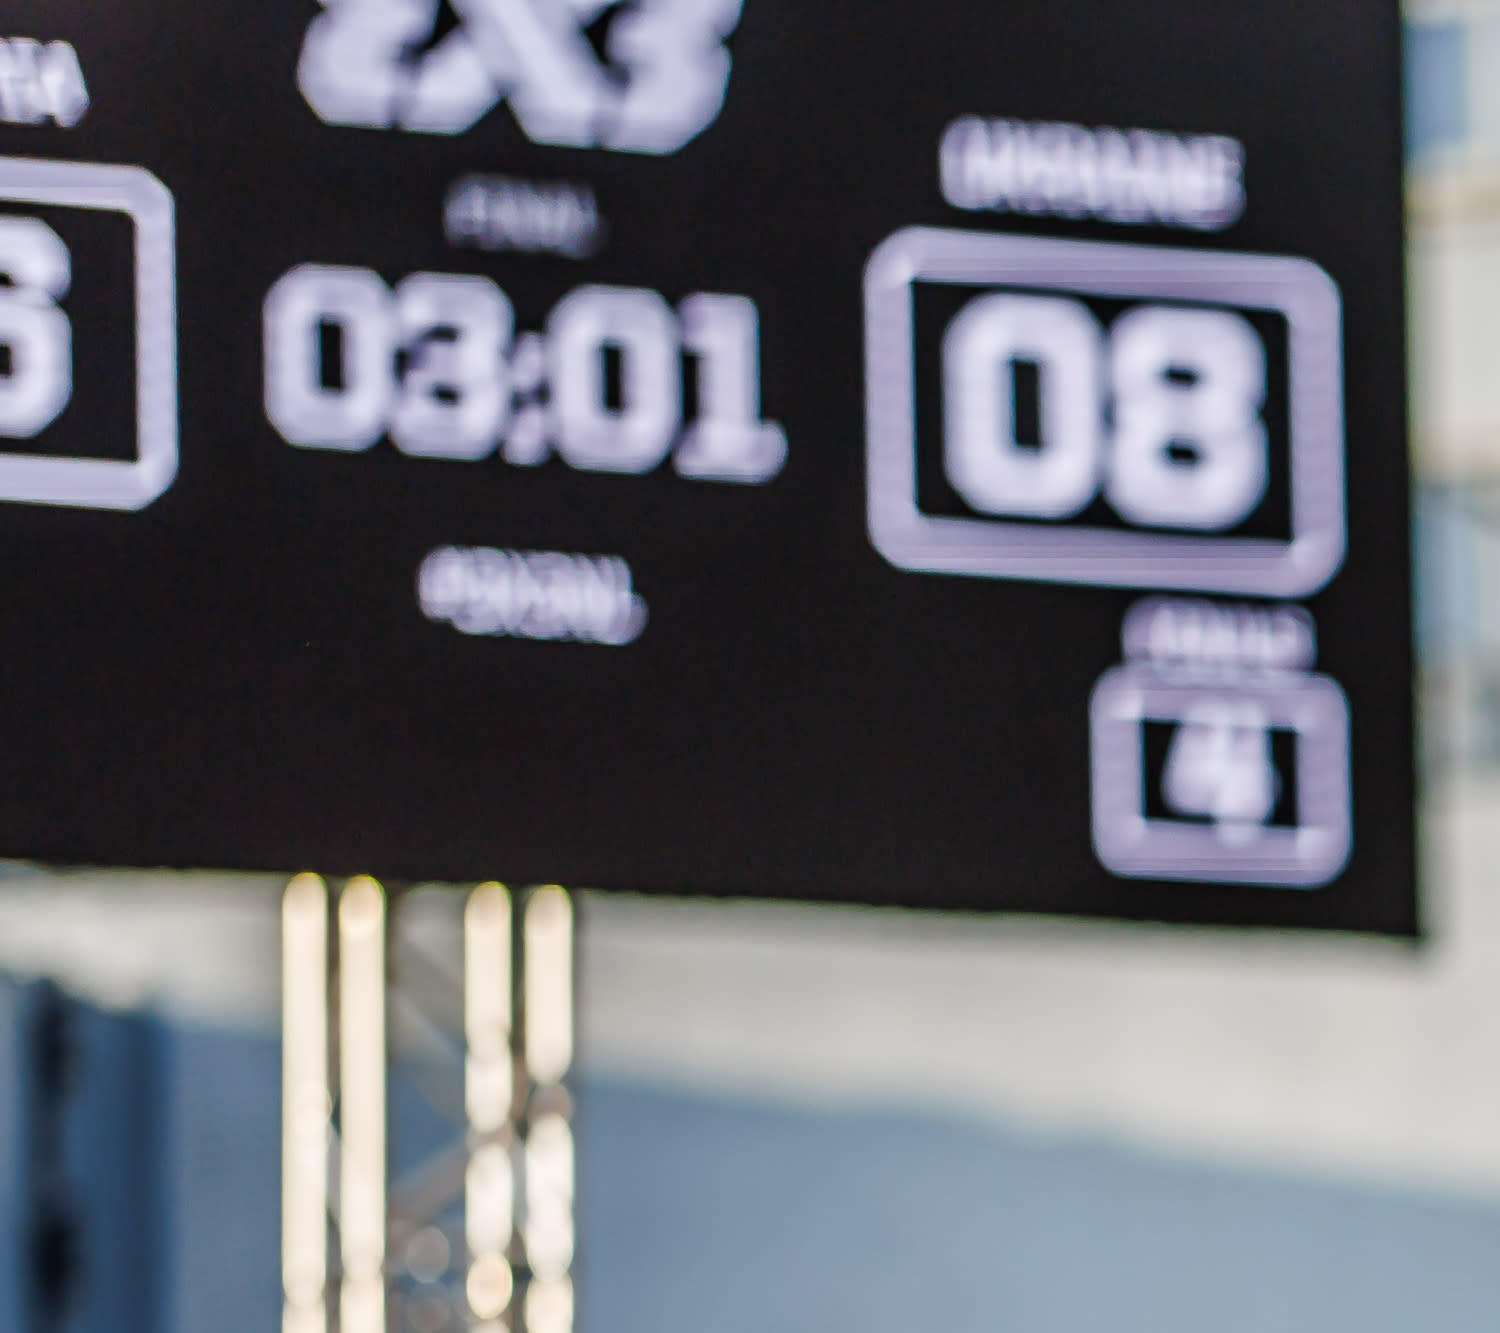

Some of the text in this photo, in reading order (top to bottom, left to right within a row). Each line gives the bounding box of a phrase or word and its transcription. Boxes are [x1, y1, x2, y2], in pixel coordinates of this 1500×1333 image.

[942, 114, 1246, 230] UKRAINE
[262, 264, 786, 483] 03:01
[942, 293, 1269, 531] 08
